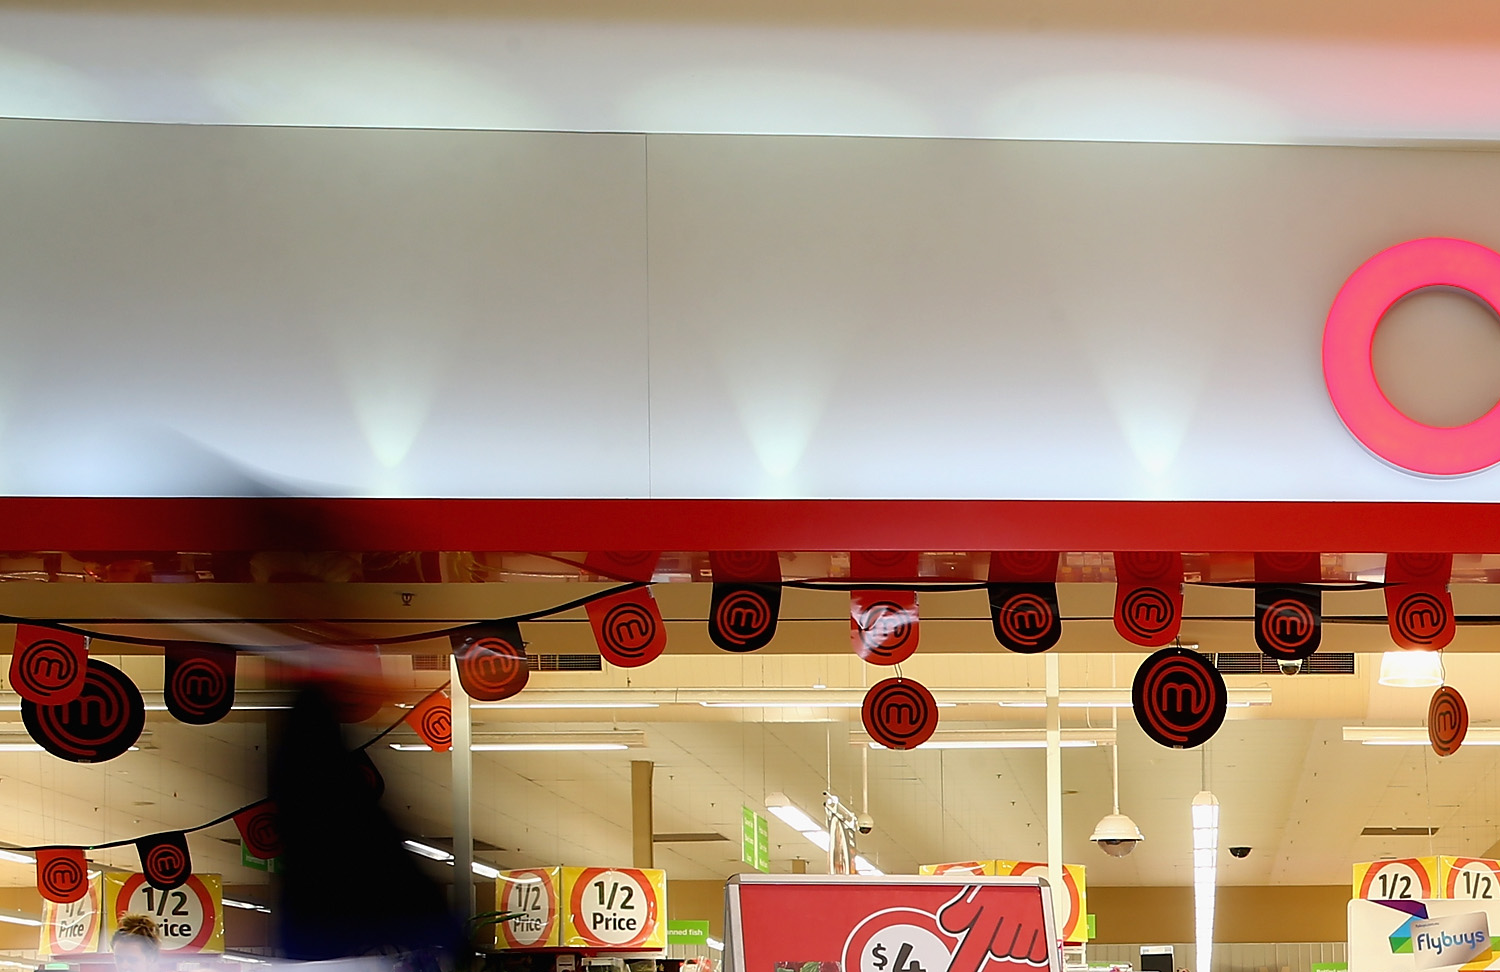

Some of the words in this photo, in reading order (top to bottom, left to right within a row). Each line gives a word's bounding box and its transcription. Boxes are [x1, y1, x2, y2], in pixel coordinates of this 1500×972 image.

[515, 883, 541, 912] 1/2
[594, 881, 635, 911] 1/2
[1378, 873, 1412, 899] 1/2
[1463, 871, 1493, 899] 1/2
[142, 887, 189, 917] 1/2
[58, 921, 85, 939] Price
[158, 918, 192, 937] rice
[512, 916, 542, 933] Price
[592, 912, 637, 932] Price
[689, 928, 703, 936] fish
[1417, 929, 1486, 955] flybuys
